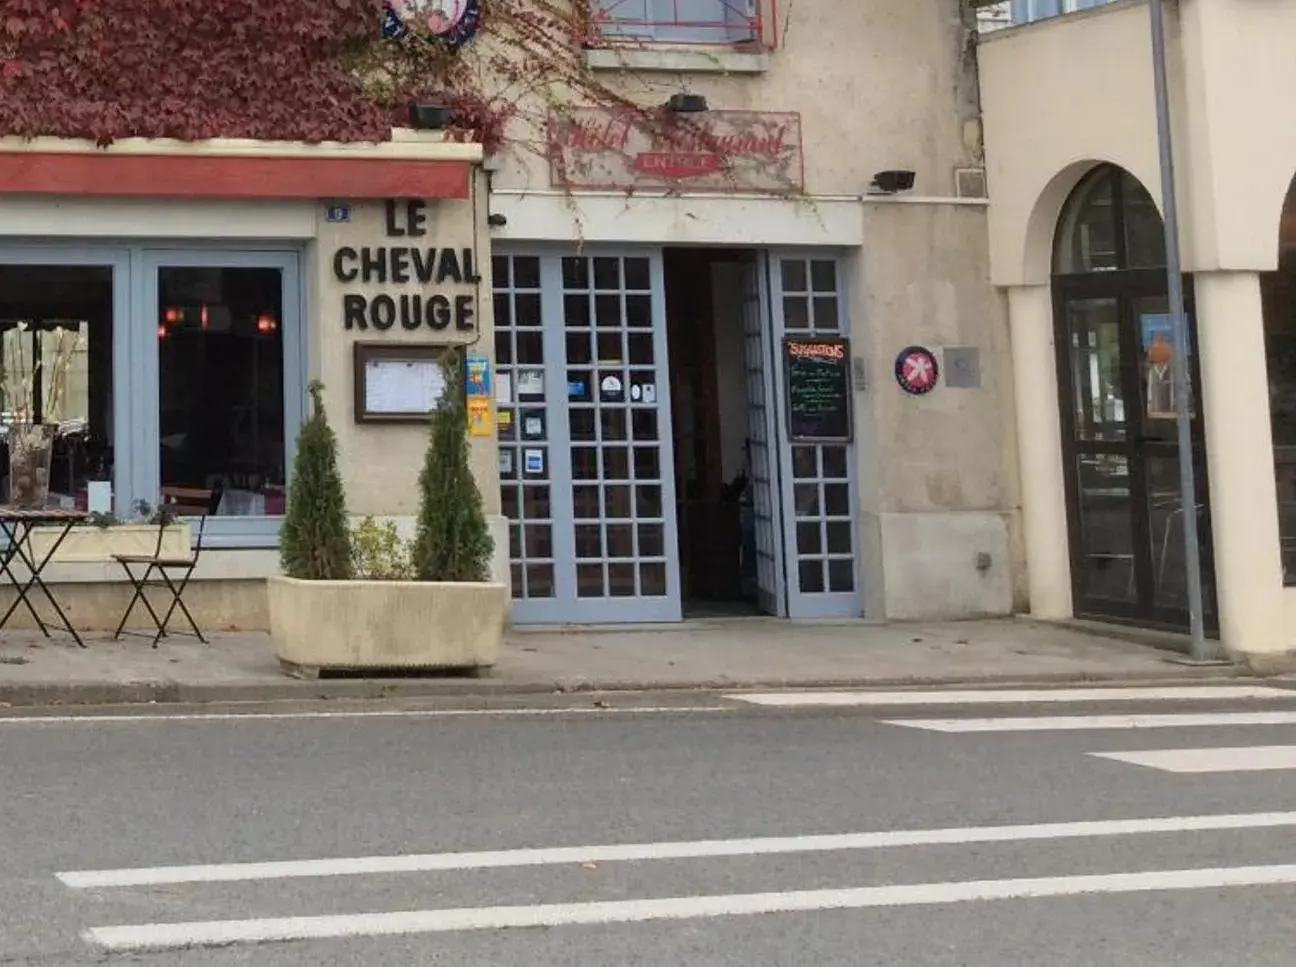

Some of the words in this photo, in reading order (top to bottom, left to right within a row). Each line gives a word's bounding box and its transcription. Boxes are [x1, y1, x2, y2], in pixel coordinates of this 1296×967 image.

[385, 198, 427, 236] LE
[333, 246, 482, 284] CHEVAL
[343, 294, 475, 330] ROUGE
